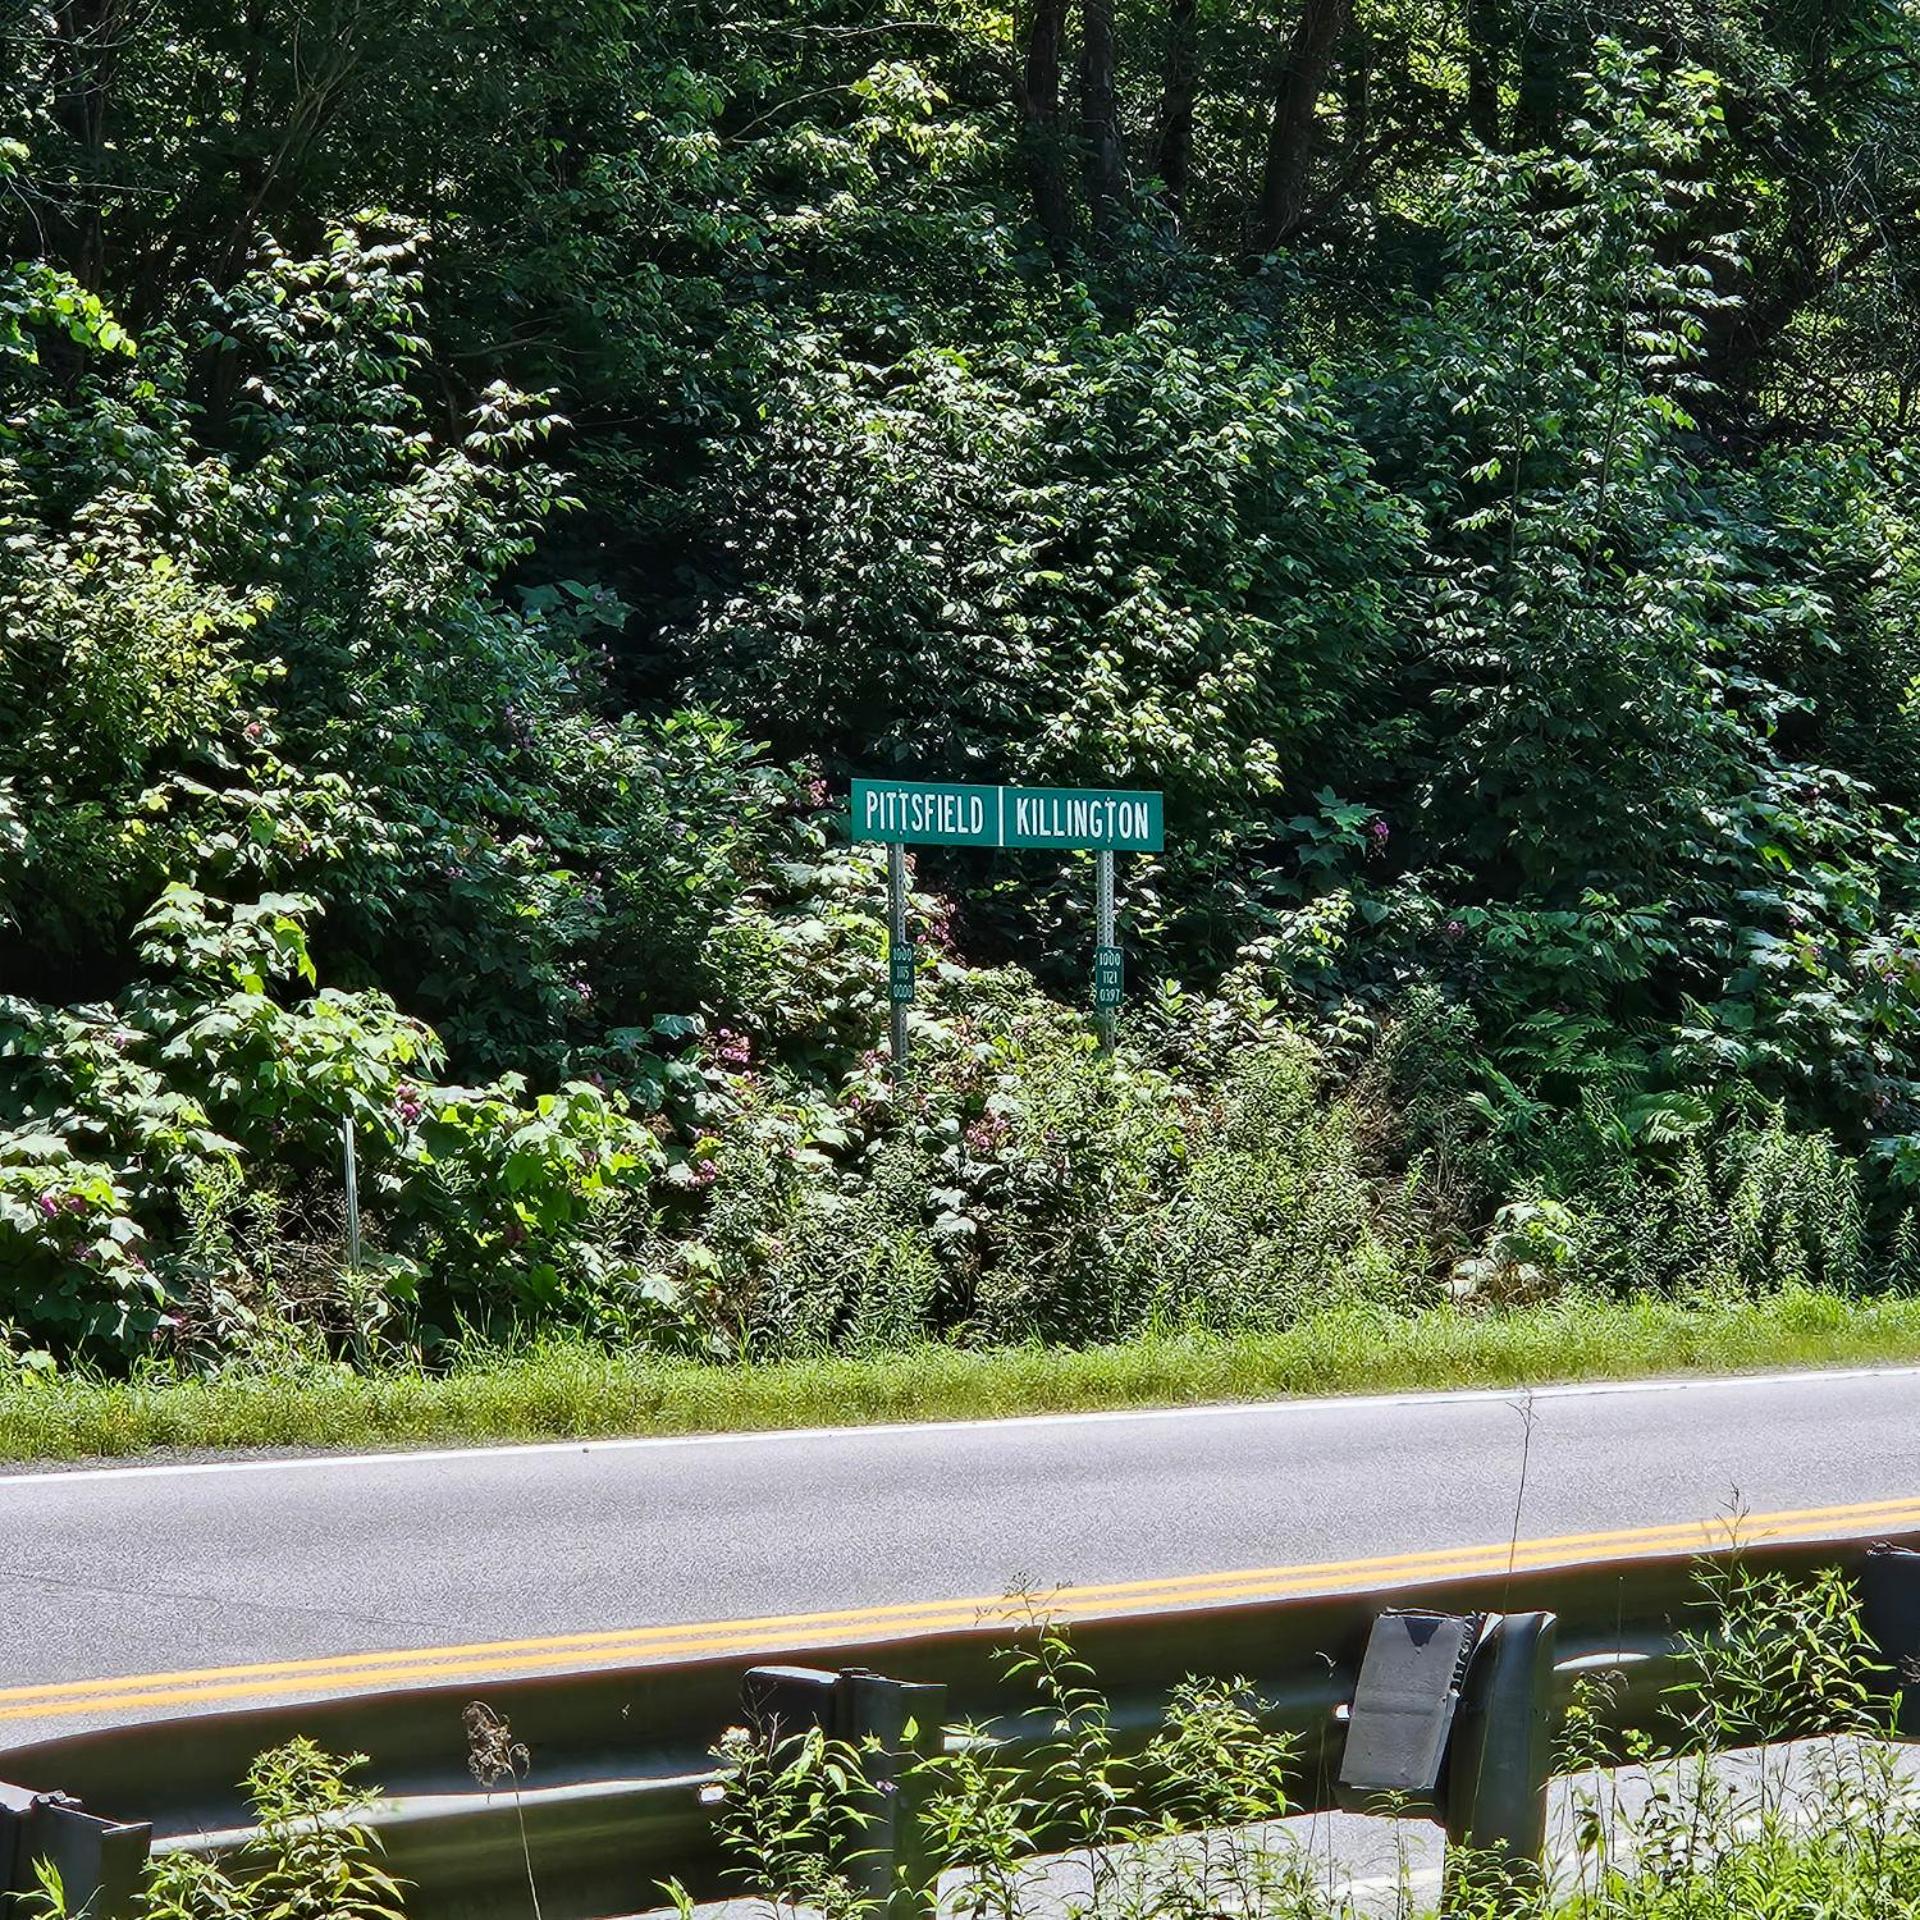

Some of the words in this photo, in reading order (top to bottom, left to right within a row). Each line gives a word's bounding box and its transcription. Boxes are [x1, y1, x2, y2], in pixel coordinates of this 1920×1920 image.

[866, 789, 984, 835] PITTSFIELD
[1016, 797, 1149, 840] KILLINGTON
[1100, 952, 1120, 966] 1000
